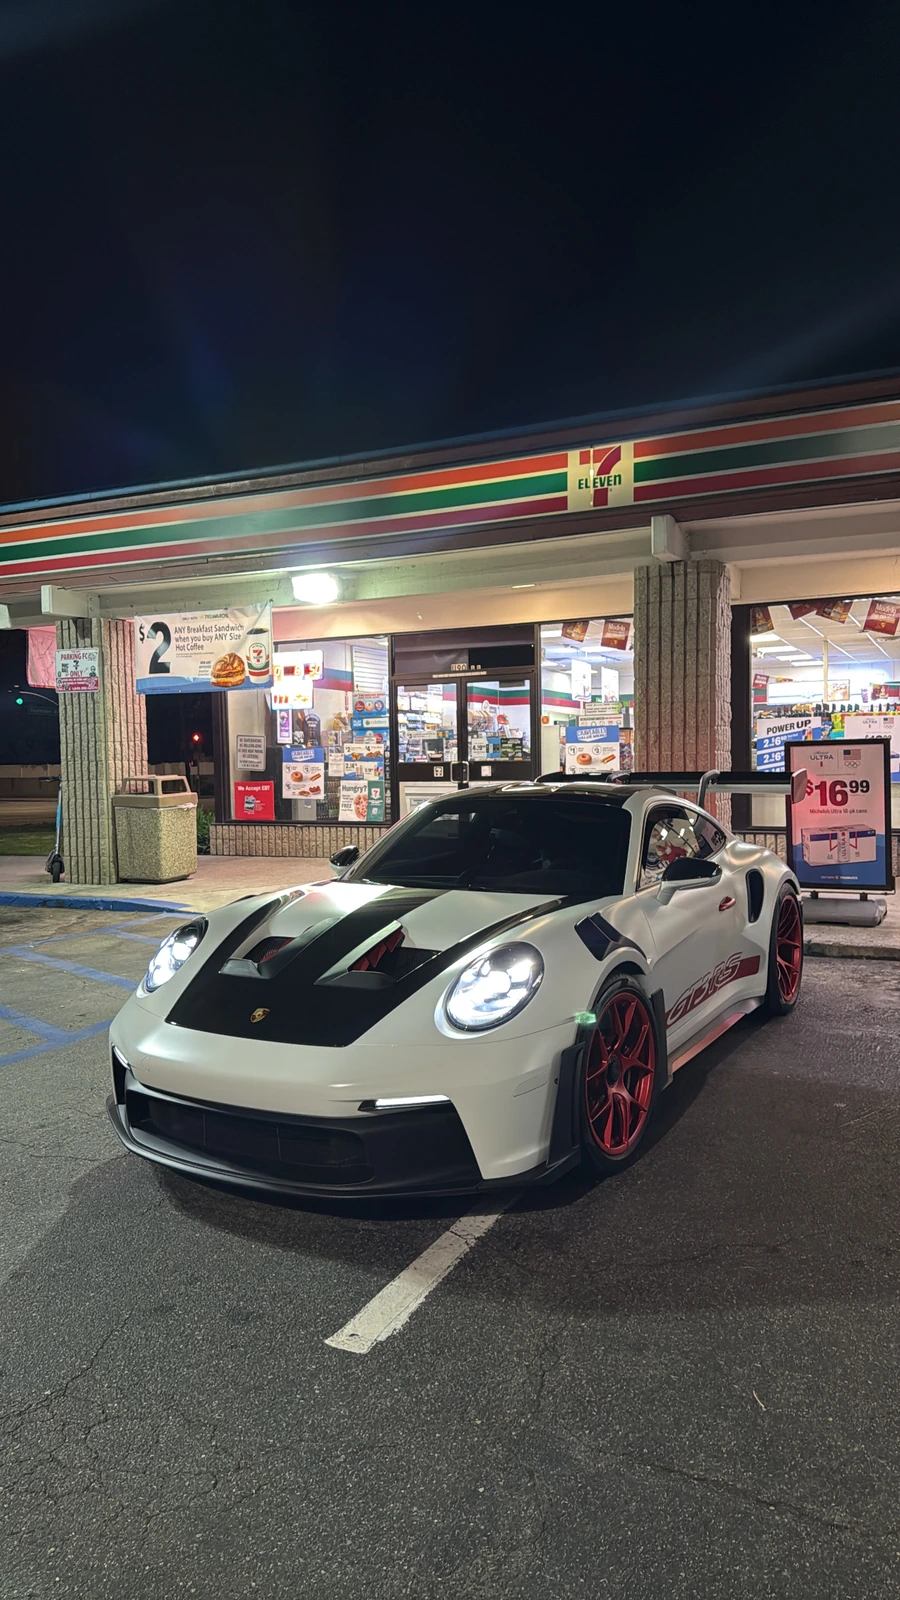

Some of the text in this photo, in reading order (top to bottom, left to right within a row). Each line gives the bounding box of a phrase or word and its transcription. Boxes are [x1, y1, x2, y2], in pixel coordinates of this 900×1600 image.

[580, 445, 621, 508] 7
[174, 624, 244, 634] ANY Breakfast Sandwich
[202, 634, 213, 642] buy
[766, 720, 812, 735] POWER UP
[763, 739, 769, 748] 2
[763, 755, 769, 763] 2
[342, 785, 367, 793] Hungry?
